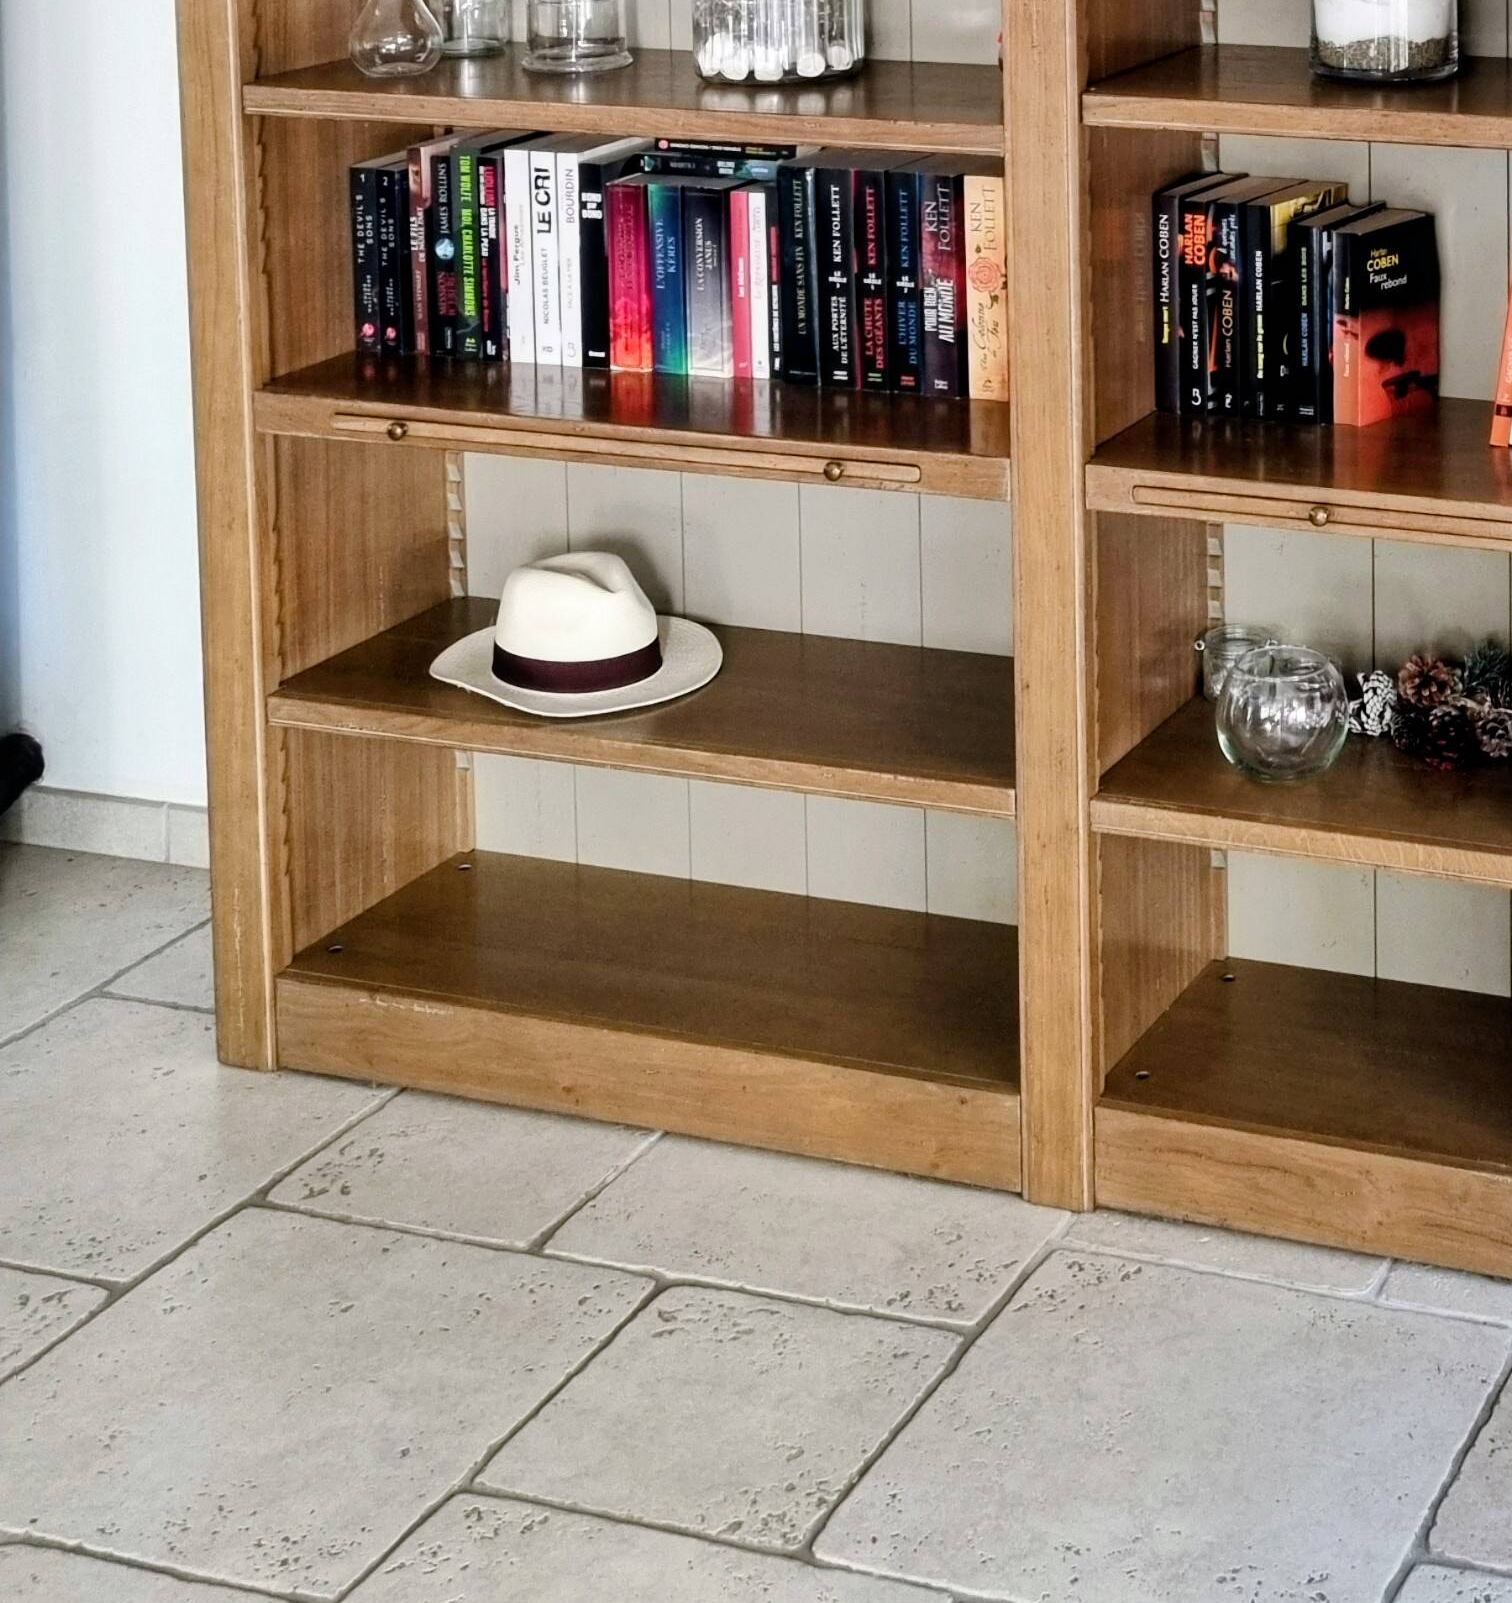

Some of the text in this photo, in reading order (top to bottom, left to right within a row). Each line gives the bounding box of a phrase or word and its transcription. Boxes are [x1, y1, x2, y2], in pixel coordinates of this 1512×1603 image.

[459, 156, 471, 173] TOM
[534, 167, 551, 207] CRI
[438, 163, 449, 234] JAMES ROLLINS
[566, 168, 575, 223] BOURDIN
[925, 201, 937, 232] KEN
[937, 183, 951, 251] FOLLETT
[970, 202, 982, 232] KEN
[537, 211, 551, 234] LE
[831, 185, 842, 262] KEN FOLLETT
[866, 187, 876, 265] KEN FOLLETT
[900, 190, 909, 267] KEN FOLLETT
[983, 189, 997, 251] FOLLETT
[1159, 214, 1169, 259] COBEN
[1184, 213, 1194, 264] HARLAN
[1194, 215, 1205, 265] COBEN
[462, 229, 474, 275] CHARLOTTE
[1367, 254, 1399, 271] COBEN
[463, 277, 476, 316] SIMMONS
[1160, 262, 1169, 302] HARLAN
[1369, 273, 1387, 283] Faux
[1381, 274, 1407, 290] rebond
[864, 298, 873, 355] LA CHUTE
[909, 301, 917, 365] DU MONDE
[925, 309, 937, 332] POUR
[938, 278, 955, 343] AU MONDE
[1222, 290, 1233, 337] COBEN
[876, 349, 884, 369] DES
